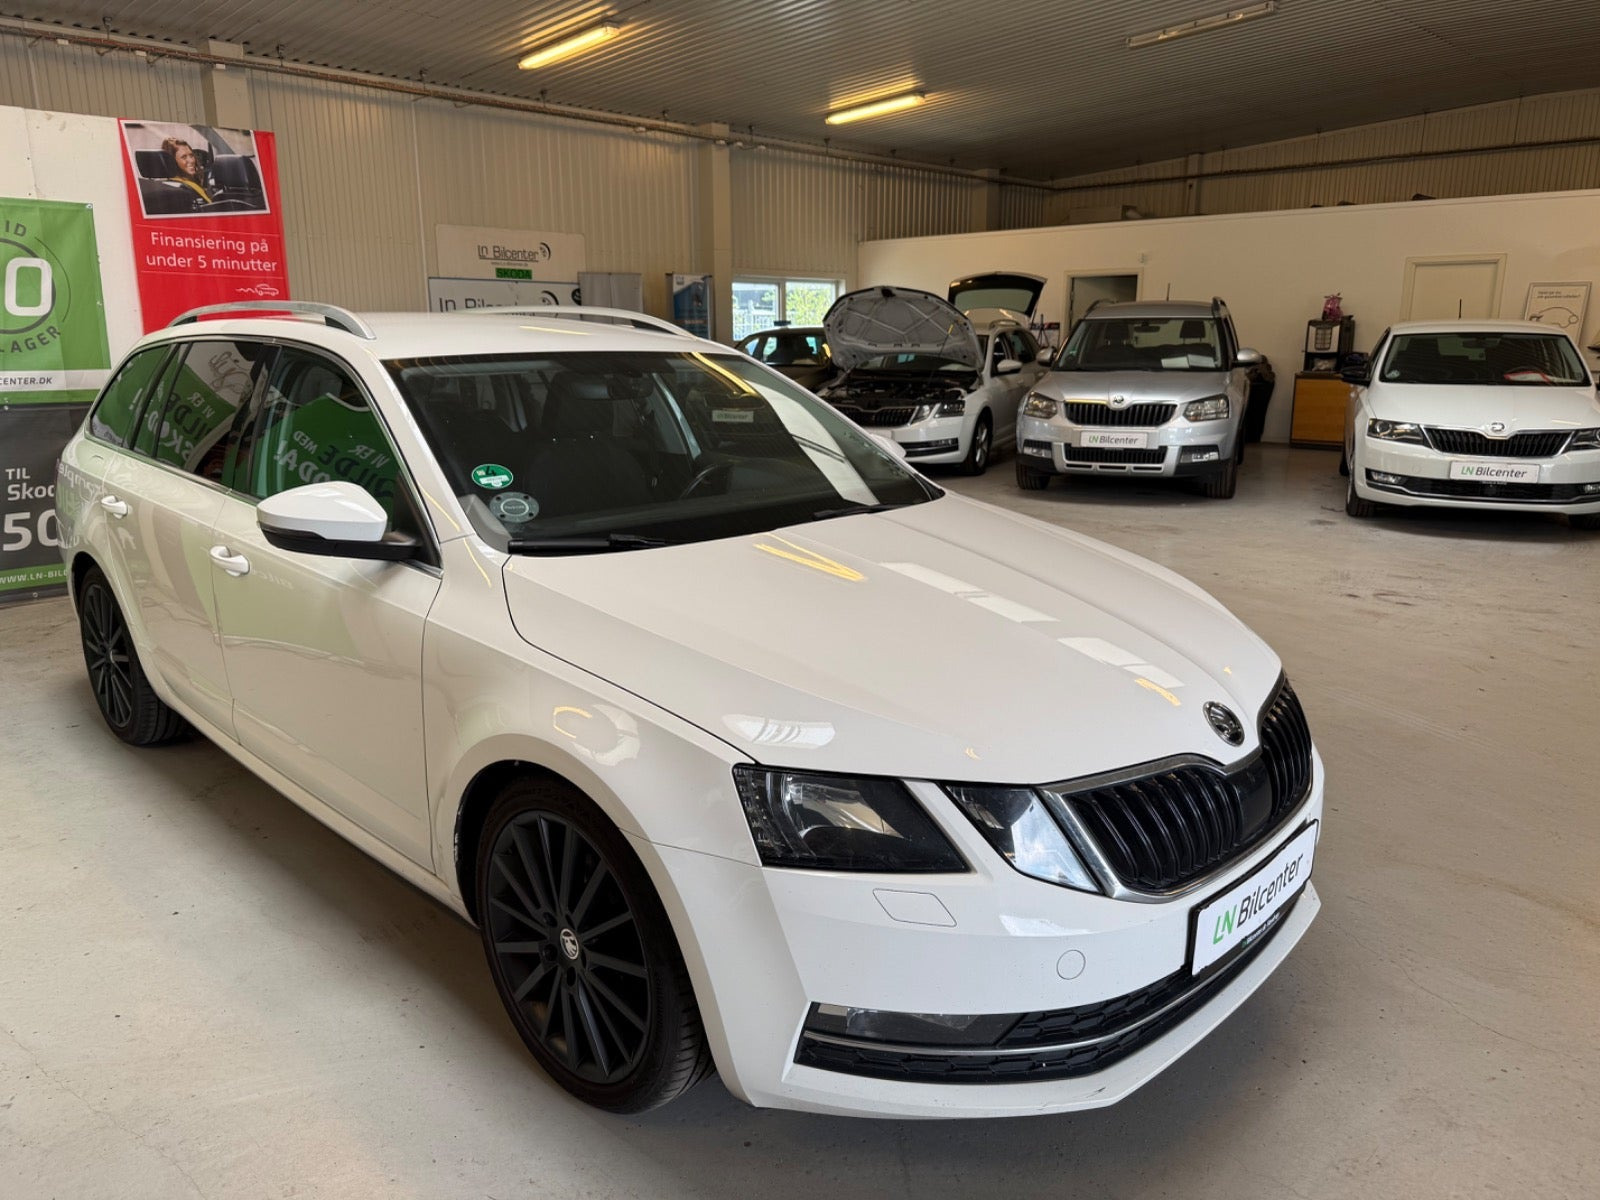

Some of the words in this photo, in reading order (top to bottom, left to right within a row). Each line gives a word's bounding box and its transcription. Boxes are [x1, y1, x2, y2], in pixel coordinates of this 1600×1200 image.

[150, 231, 246, 255] Finansiering
[250, 239, 269, 255] på
[493, 245, 539, 259] Bilcenter
[146, 253, 193, 268] under
[198, 255, 207, 269] 5
[212, 256, 278, 272] minutter
[0, 325, 61, 353] AGER
[1100, 435, 1140, 445] Bilcenter
[5, 467, 31, 480] TIL
[1461, 466, 1475, 476] LN
[1475, 466, 1528, 478] Bilcenter
[1212, 904, 1238, 945] LN
[1237, 853, 1304, 929] Bilcenter
